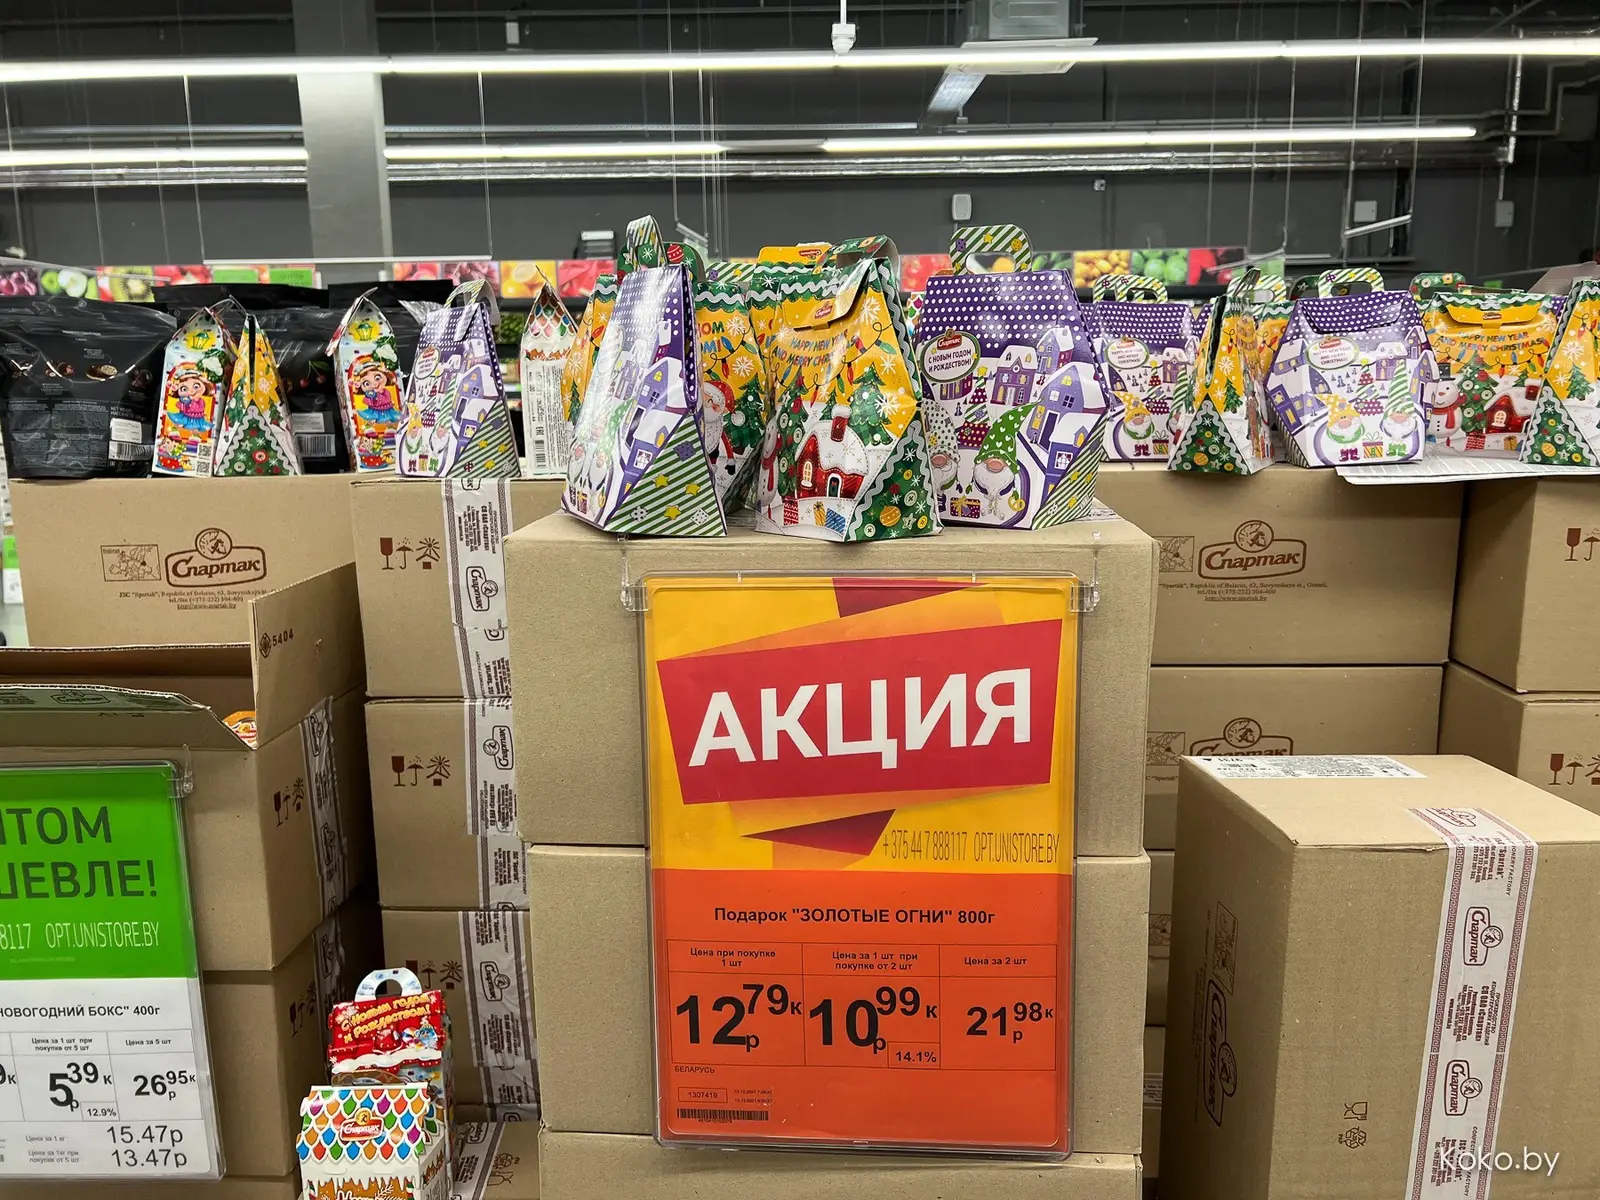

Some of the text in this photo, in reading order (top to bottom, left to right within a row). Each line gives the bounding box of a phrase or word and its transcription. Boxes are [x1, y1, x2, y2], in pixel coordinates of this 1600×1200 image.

[815, 337, 830, 352] NEW
[1508, 331, 1529, 340] YEAR
[933, 353, 951, 363] НОВЫМ
[952, 349, 971, 358] ГОДОМ
[1460, 342, 1487, 351] MERRY
[934, 359, 971, 371] РОЖДЕСТВОМ!
[172, 556, 260, 578] Спартак
[1205, 548, 1300, 571] Спартак
[471, 569, 483, 609] Спартак
[272, 628, 293, 647] 5404
[688, 668, 1031, 770] АКЦИЯ
[498, 728, 509, 767] Спартак
[891, 829, 908, 861] 375
[911, 830, 923, 862] 44
[924, 830, 931, 862] 7
[932, 830, 967, 862] 888117
[974, 832, 1060, 864] OPT.UNISTORE.BY
[714, 907, 995, 924] Подарок "ЗОЛОТЫЕ ОГНИ" 800г
[45, 921, 159, 948] OPT.UNISTORE.BY
[1469, 909, 1486, 963] Спартак
[690, 948, 776, 959] Цена при покупке
[721, 959, 726, 967] 1
[832, 951, 856, 960] Цена
[873, 952, 878, 960] 1
[899, 953, 918, 961] при
[964, 956, 989, 966] Цена
[1005, 957, 1010, 965] 2
[835, 962, 875, 971] покупке
[891, 962, 896, 970] 2
[1481, 986, 1490, 994] СП
[1479, 995, 1488, 1008] ОАО
[1487, 981, 1497, 1021] КОНДИТЕРСКИХ
[88, 1006, 129, 1017] БОКС"
[133, 1005, 160, 1016] 400г
[676, 995, 746, 1045] 12
[742, 984, 789, 1015] 79
[809, 999, 879, 1047] 10
[875, 986, 921, 1016] 99
[966, 1006, 1007, 1036] 21
[1013, 1002, 1043, 1022] 98
[1491, 992, 1500, 1034] ПРОИЗВОДСТВО
[79, 1038, 93, 1046] при
[896, 1051, 937, 1063] 14.1%
[1208, 992, 1224, 1113] Спартак
[674, 1065, 715, 1074] БЕЛАРУСЬ
[49, 1073, 74, 1107] 5
[66, 1062, 99, 1084] 39
[133, 1074, 167, 1096] 26
[167, 1070, 188, 1084] 95
[1449, 1062, 1466, 1113] Спартак
[86, 1108, 117, 1117] 12.9%
[106, 1125, 183, 1147] 15.47р
[344, 1122, 380, 1135] Спартак
[111, 1149, 188, 1168] 13.47р
